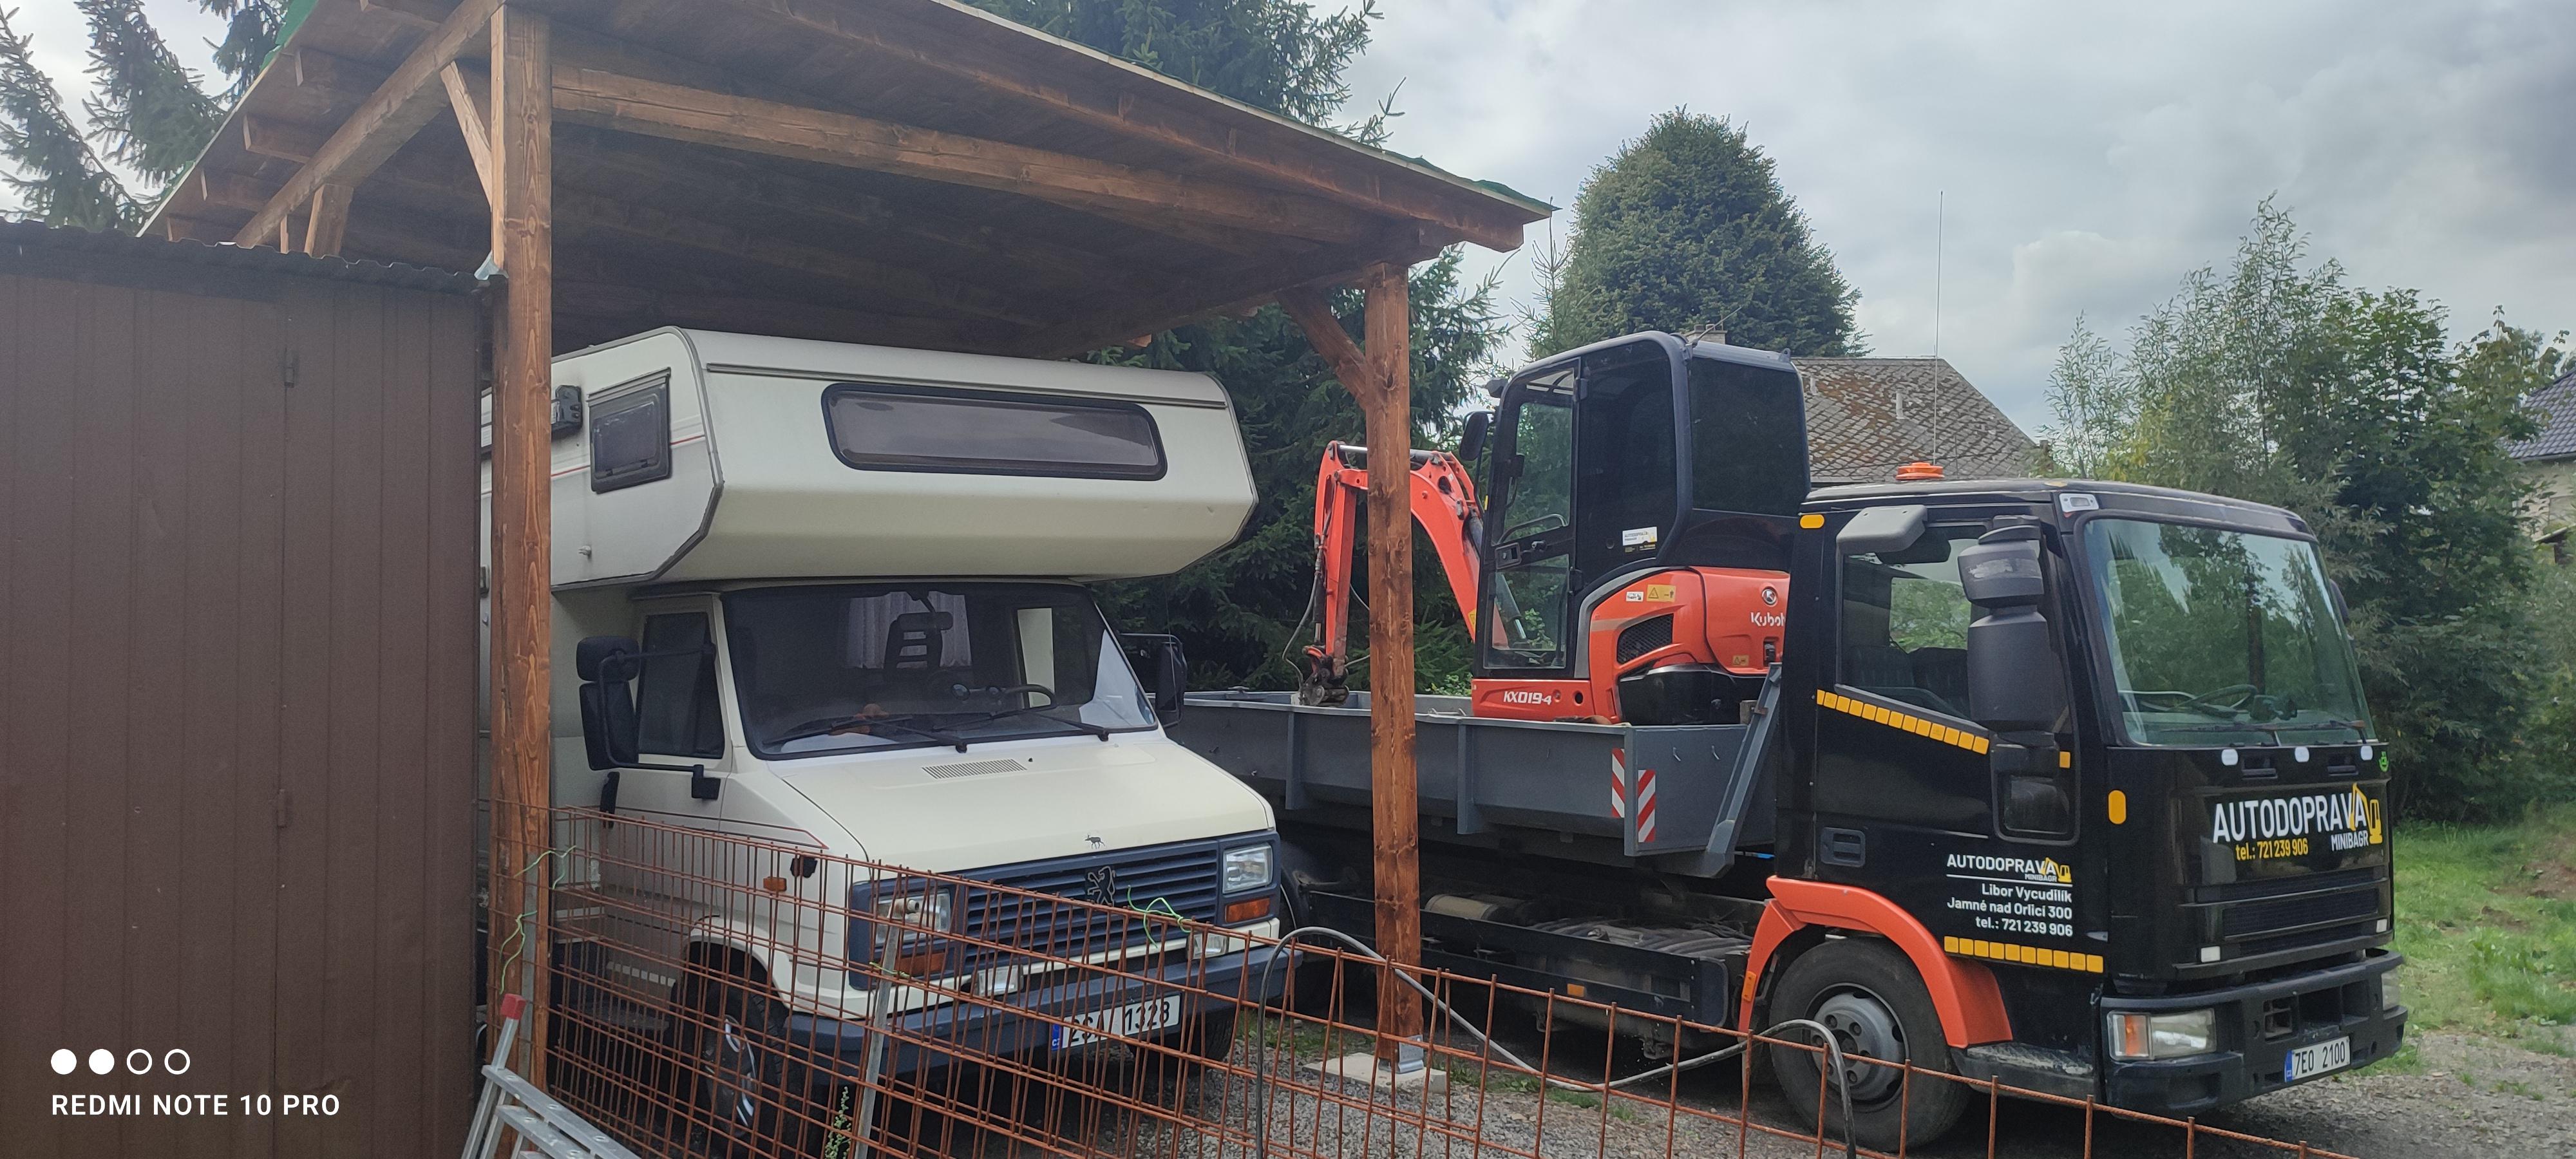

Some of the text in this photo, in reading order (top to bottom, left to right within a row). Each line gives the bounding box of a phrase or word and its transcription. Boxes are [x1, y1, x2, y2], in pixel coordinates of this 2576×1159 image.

[1750, 612, 1786, 627] Kubot
[1504, 691, 1552, 705] KX019-4
[2213, 793, 2367, 843] AUTODOPRAVA
[2235, 838, 2309, 861] tel.: 721 239 906
[2331, 831, 2369, 851] MINIBAGR
[1947, 854, 2056, 875] AUTODOPRAVA
[1982, 883, 2013, 898] Libor
[1947, 897, 1987, 912] Jamné
[1989, 902, 2011, 914] nad
[2047, 905, 2072, 920] 300
[1975, 916, 2073, 937] tel.: 721 239 906
[1124, 1001, 1170, 1032] 1328
[2322, 1041, 2345, 1068] 2100
